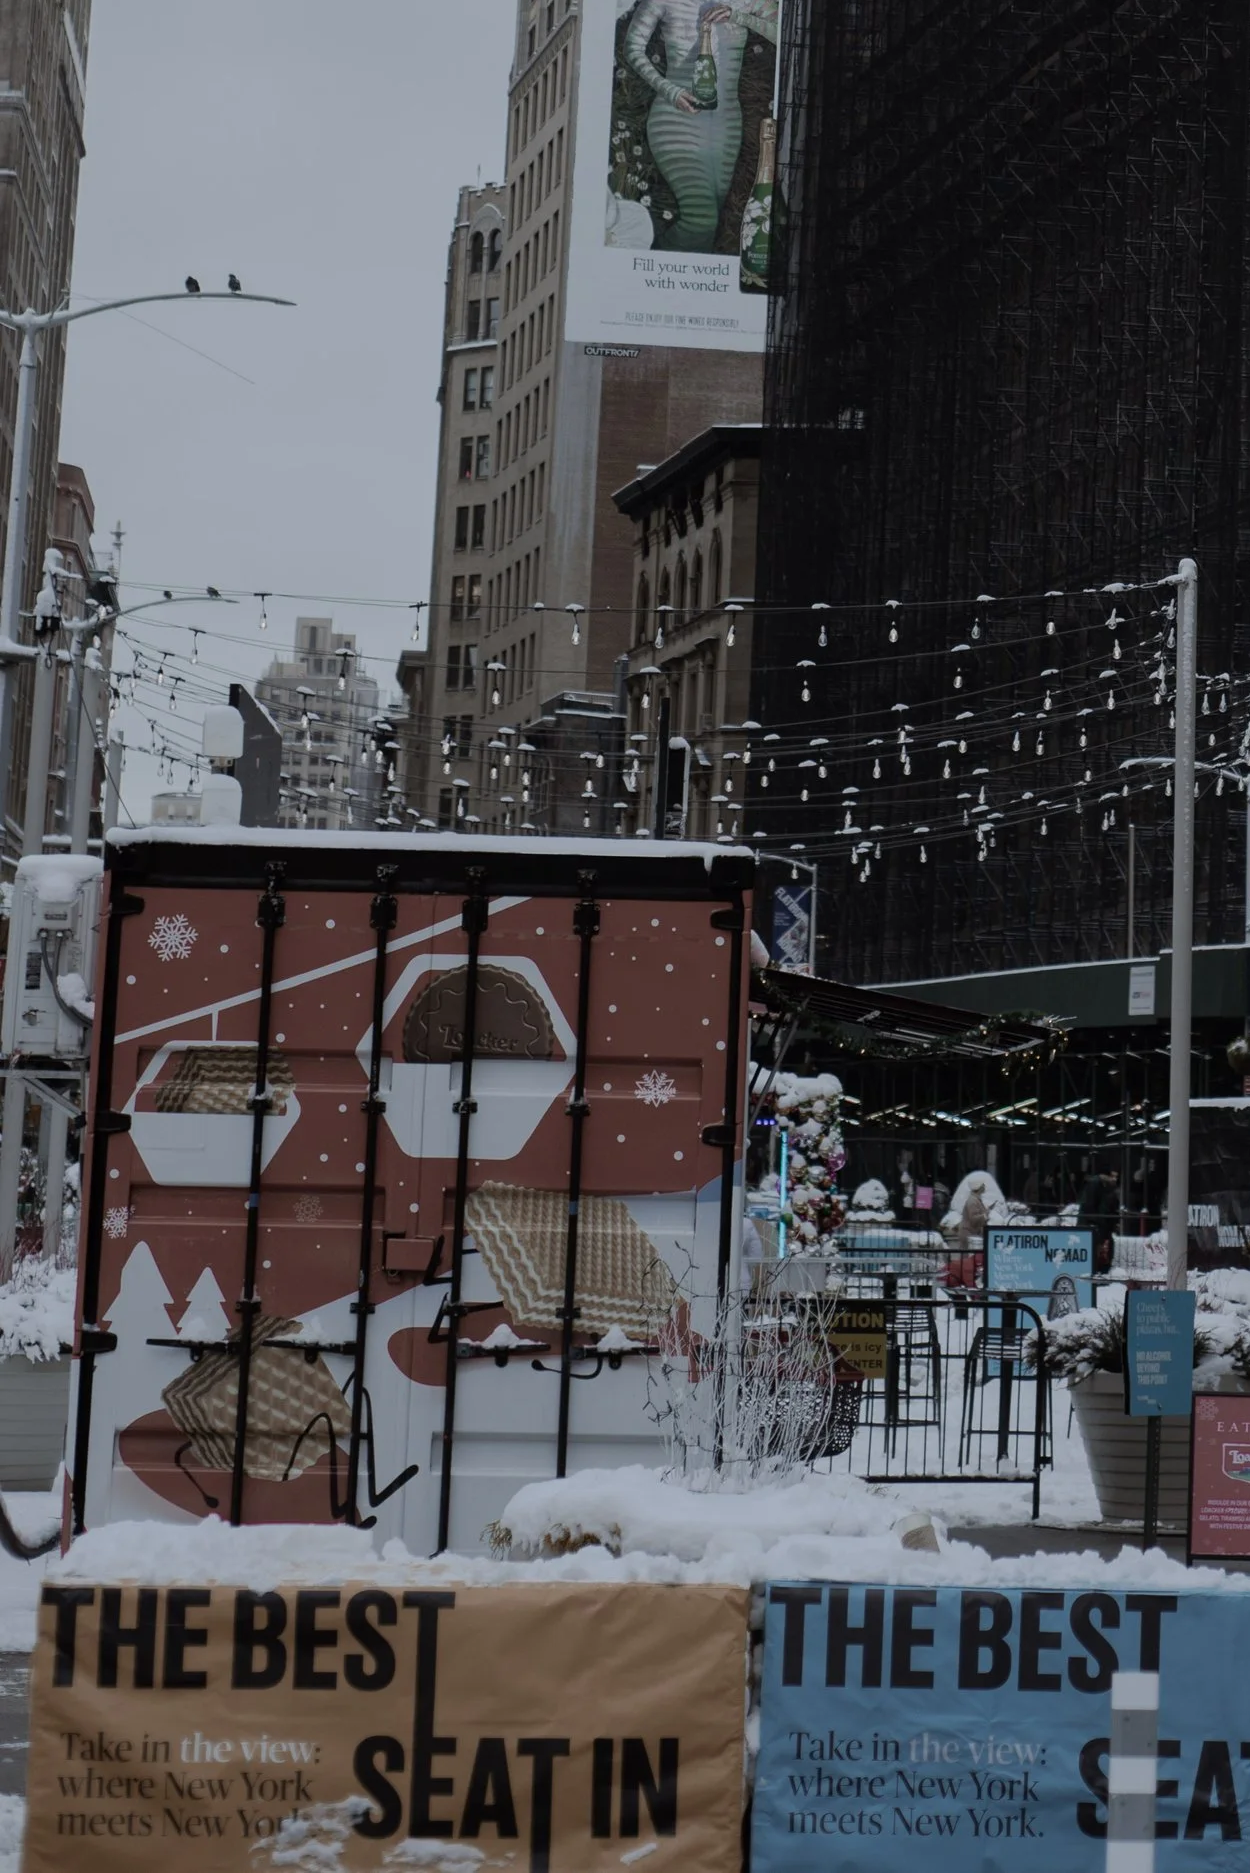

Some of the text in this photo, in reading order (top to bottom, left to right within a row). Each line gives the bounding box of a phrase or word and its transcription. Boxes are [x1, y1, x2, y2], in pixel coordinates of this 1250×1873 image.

[632, 257, 730, 279] Fill your world
[644, 276, 730, 293] with wonder
[865, 1342, 881, 1354] icy
[770, 1586, 1178, 1694] THE BEST
[42, 1587, 456, 1738] THE BEST
[60, 1731, 321, 1764] Take in the view:
[789, 1730, 1047, 1765] Take in the view:
[58, 1768, 316, 1802] where New York
[788, 1767, 1040, 1802] where New York
[353, 1735, 679, 1873] SEAT IN
[57, 1810, 153, 1836] meets
[162, 1807, 232, 1837] New
[788, 1807, 1044, 1838] meets New York.
